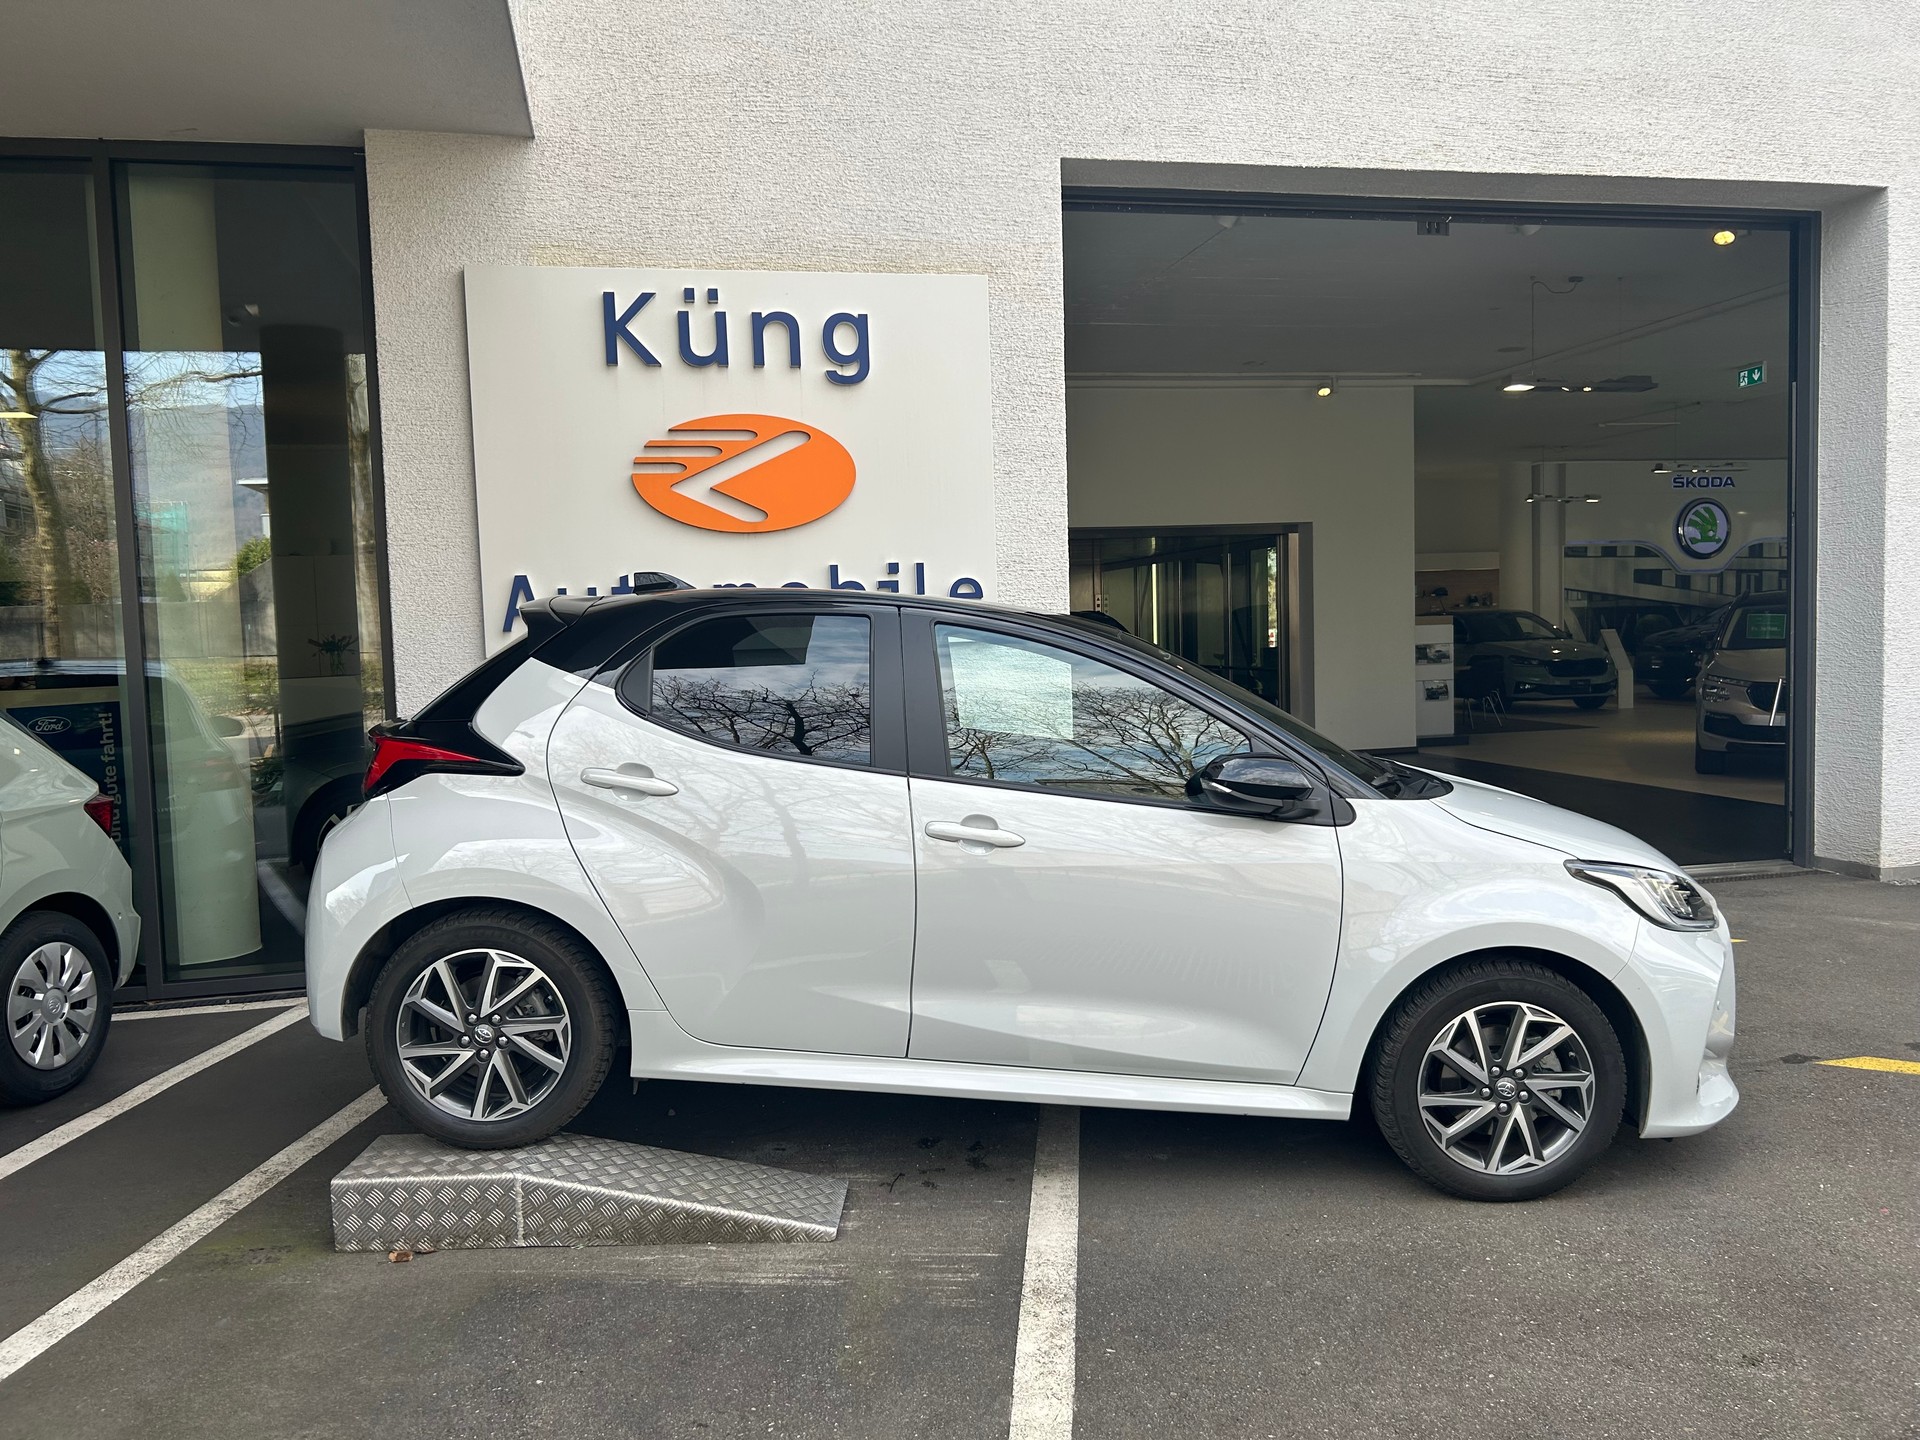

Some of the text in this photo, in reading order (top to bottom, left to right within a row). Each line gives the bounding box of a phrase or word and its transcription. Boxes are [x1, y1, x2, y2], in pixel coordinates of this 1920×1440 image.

[602, 287, 871, 386] Küng
[1672, 474, 1736, 489] ŠKODA
[35, 718, 64, 732] Ford
[98, 711, 116, 763] fahrt!
